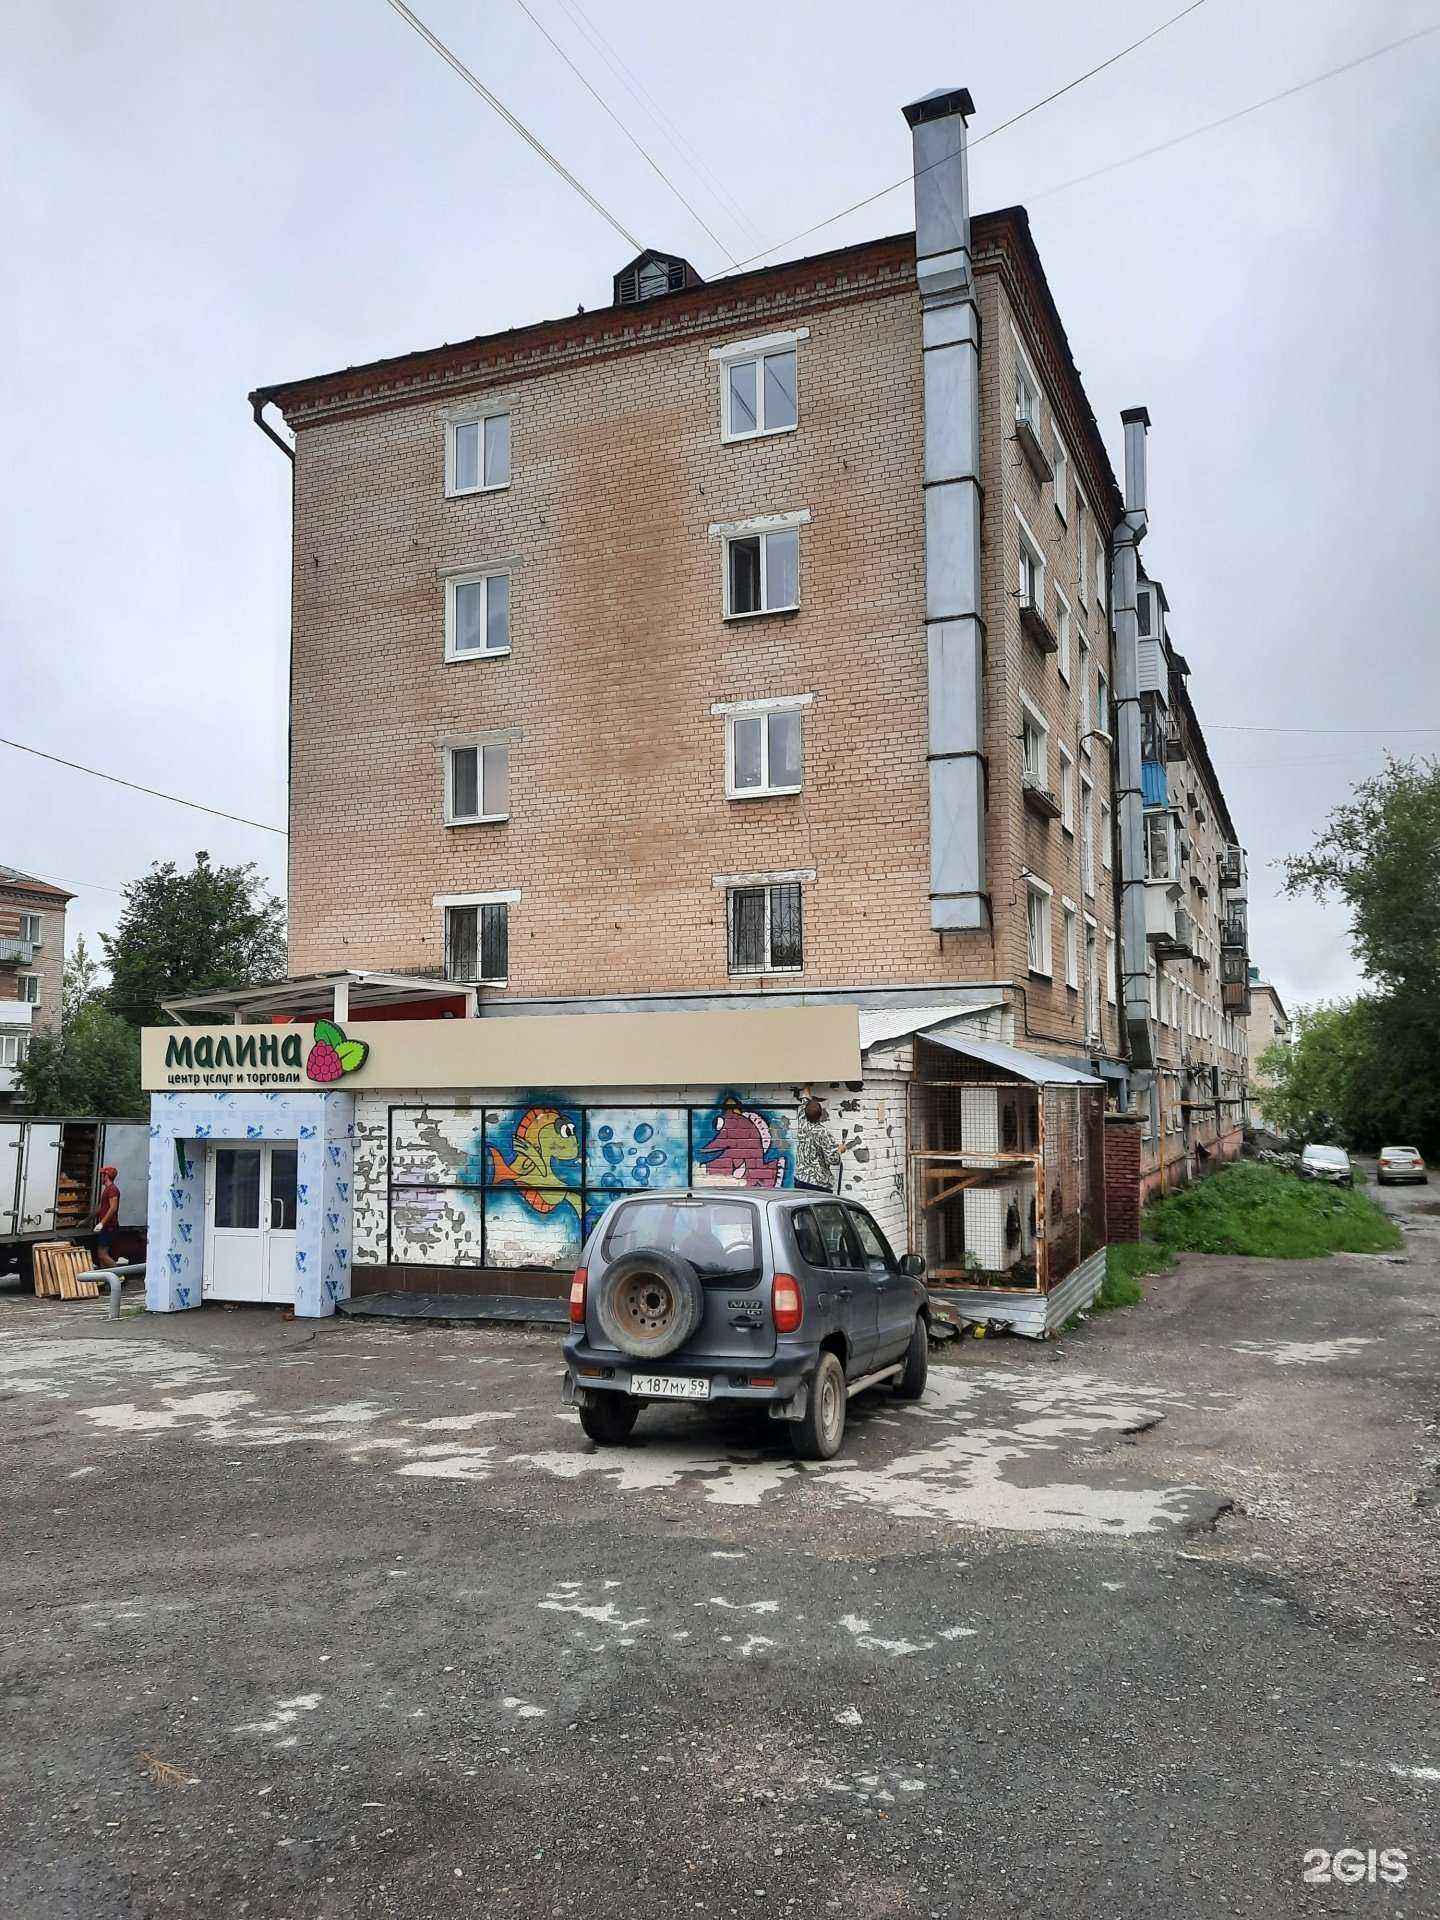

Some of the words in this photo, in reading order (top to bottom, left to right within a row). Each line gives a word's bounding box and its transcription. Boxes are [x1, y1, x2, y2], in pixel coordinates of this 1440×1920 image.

[167, 1073, 200, 1085] центр
[203, 1073, 234, 1086] услуг
[237, 1074, 243, 1083] и
[247, 1073, 301, 1085] торговли
[730, 1300, 761, 1309] NIVA
[691, 1380, 705, 1391] 59
